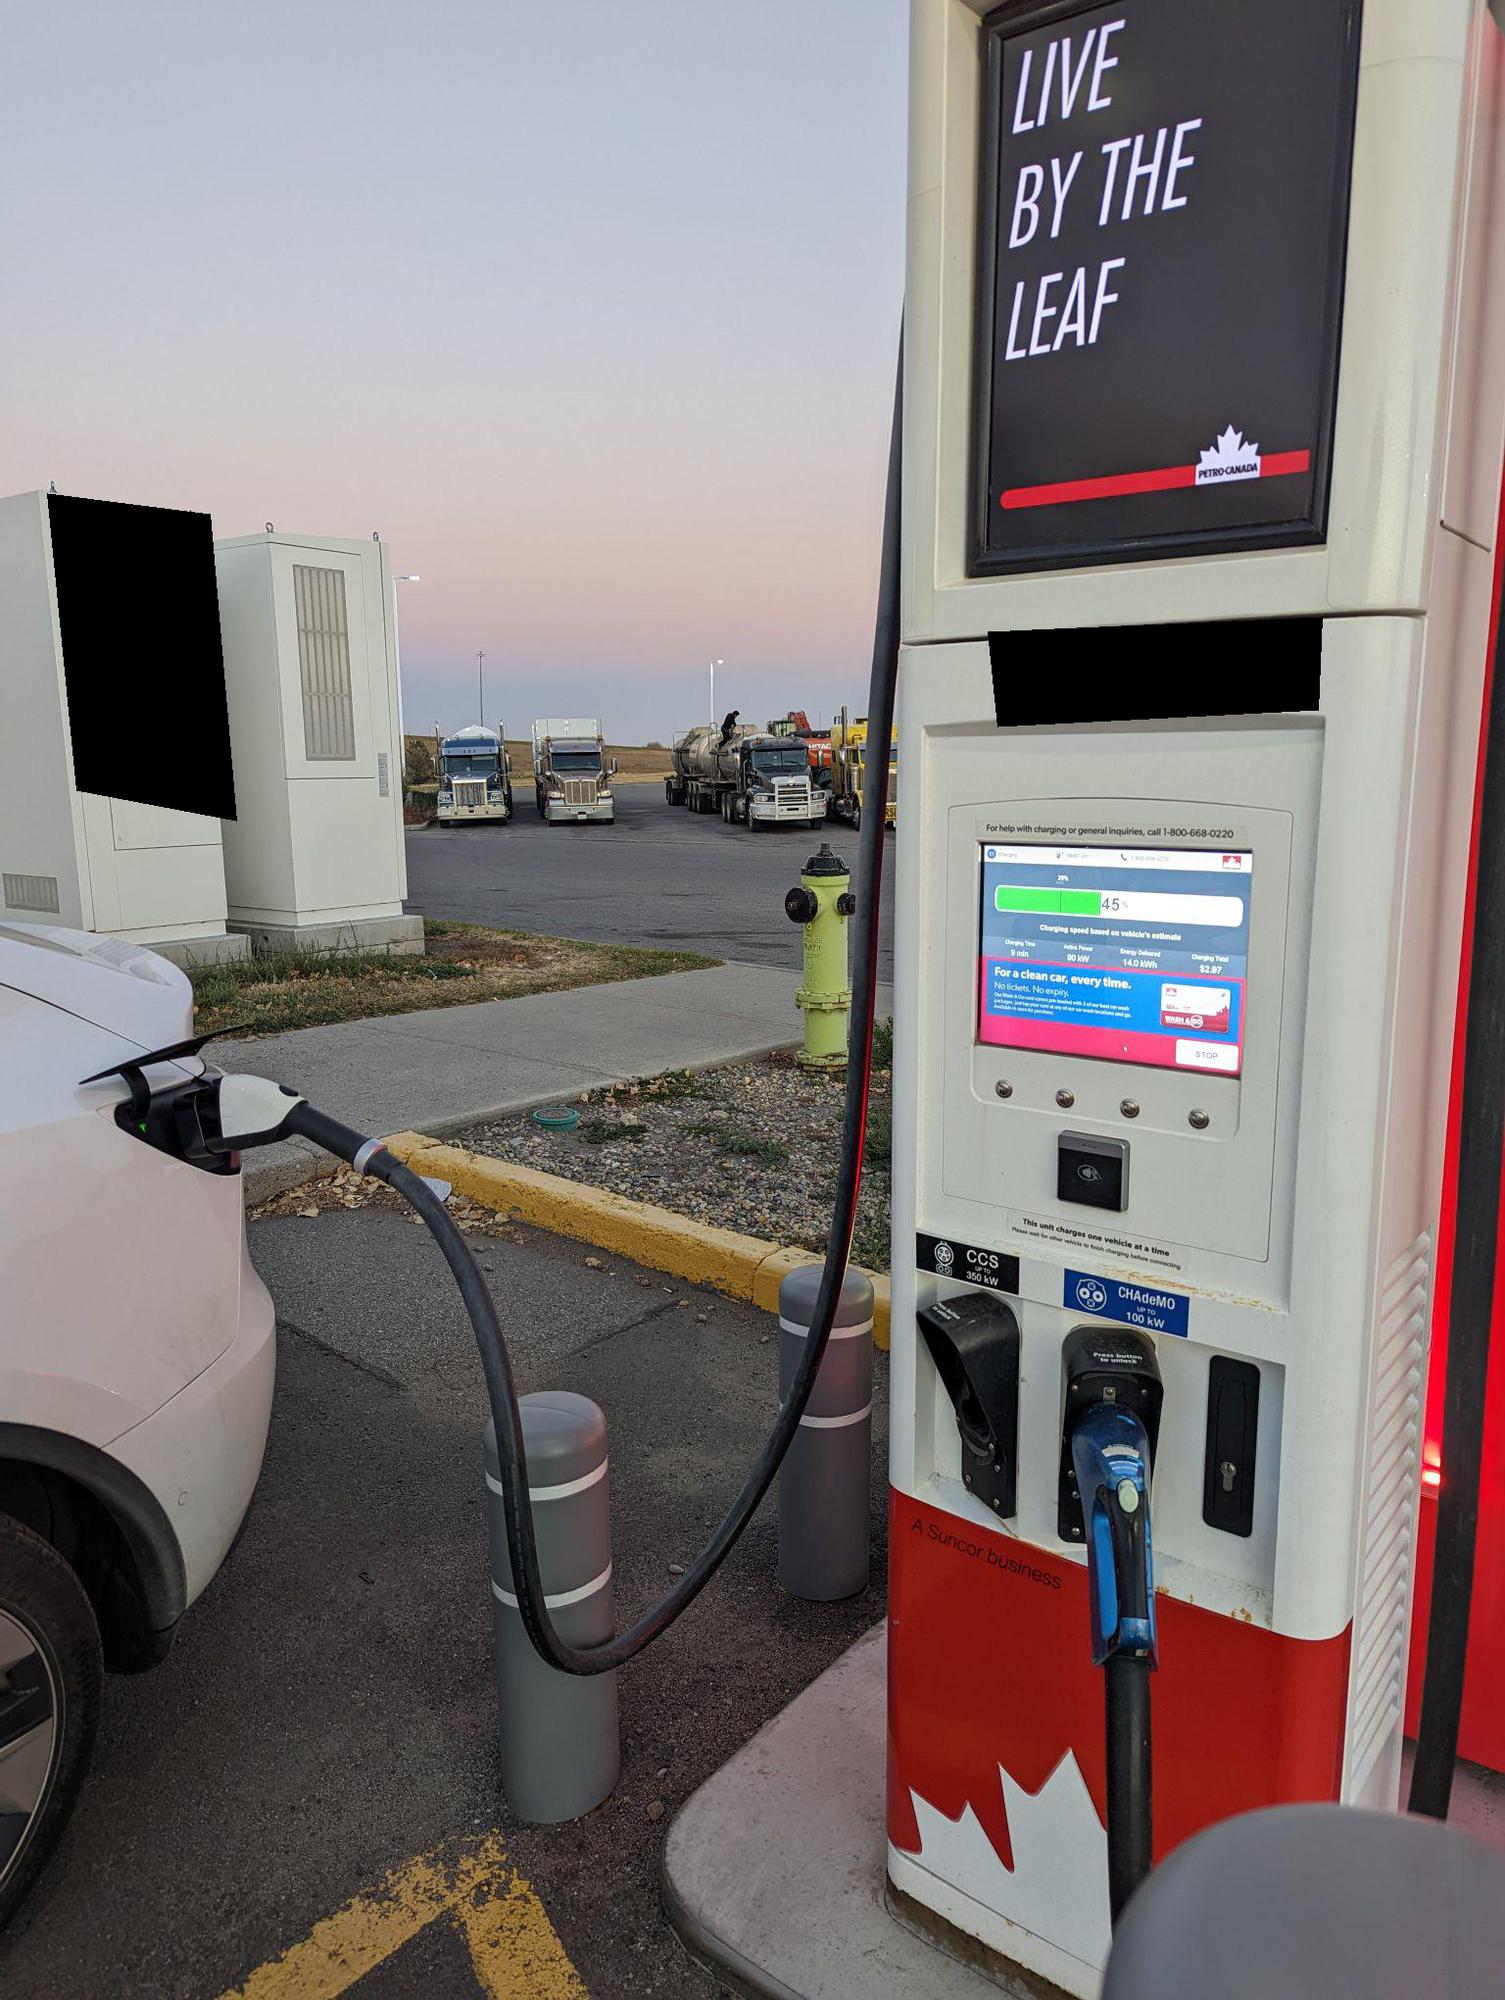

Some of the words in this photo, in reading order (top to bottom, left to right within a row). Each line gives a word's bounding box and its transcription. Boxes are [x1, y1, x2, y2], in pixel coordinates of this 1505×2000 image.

[1012, 19, 1126, 134] LIVE
[1009, 151, 1083, 249] BY
[1099, 118, 1202, 225] THE
[1005, 257, 1126, 360] LEAF
[1198, 463, 1258, 479] PETRO-CANADA
[986, 824, 998, 832] For
[999, 824, 1016, 833] help
[1016, 825, 1032, 833] with
[1034, 826, 1067, 836] charging
[1078, 827, 1108, 836] general
[1108, 827, 1145, 837] inquiries,
[1147, 828, 1160, 836] call
[1163, 828, 1234, 839] 1-800-668-0220
[1040, 924, 1069, 934] Charging
[1070, 927, 1088, 935] speed
[1090, 928, 1110, 936] based
[1121, 930, 1151, 939] vehicle's
[1152, 932, 1182, 942] estimate
[1016, 950, 1029, 958] min
[1067, 954, 1076, 962] 90
[1078, 954, 1090, 963] kW
[1140, 960, 1158, 969] kWh
[994, 966, 1012, 978] For
[1020, 969, 1048, 981] clean
[1050, 974, 1068, 984] car,
[1070, 975, 1102, 989] every
[1102, 977, 1132, 990] time.
[994, 981, 1006, 990] No
[1006, 982, 1031, 993] tickets.
[1032, 985, 1044, 994] No
[1196, 1051, 1218, 1059] STOP
[1023, 1218, 1038, 1227] This
[1040, 1223, 1054, 1231] unit
[1056, 1226, 1086, 1238] charges
[1088, 1233, 1102, 1242] one
[1104, 1237, 1132, 1248] vehicle
[1151, 1247, 1170, 1256] time
[966, 1249, 999, 1269] CCS
[1106, 1248, 1130, 1258] charging
[1130, 1252, 1148, 1262] before
[1150, 1258, 1181, 1271] connecting
[966, 1271, 982, 1282] 350
[984, 1275, 998, 1286] kW
[1118, 1286, 1176, 1310] CHAdeMO
[1126, 1311, 1145, 1324] 100
[1147, 1317, 1165, 1329] kW
[911, 1518, 923, 1534] A
[927, 1524, 985, 1558] Suncor
[987, 1549, 1062, 1590] business
